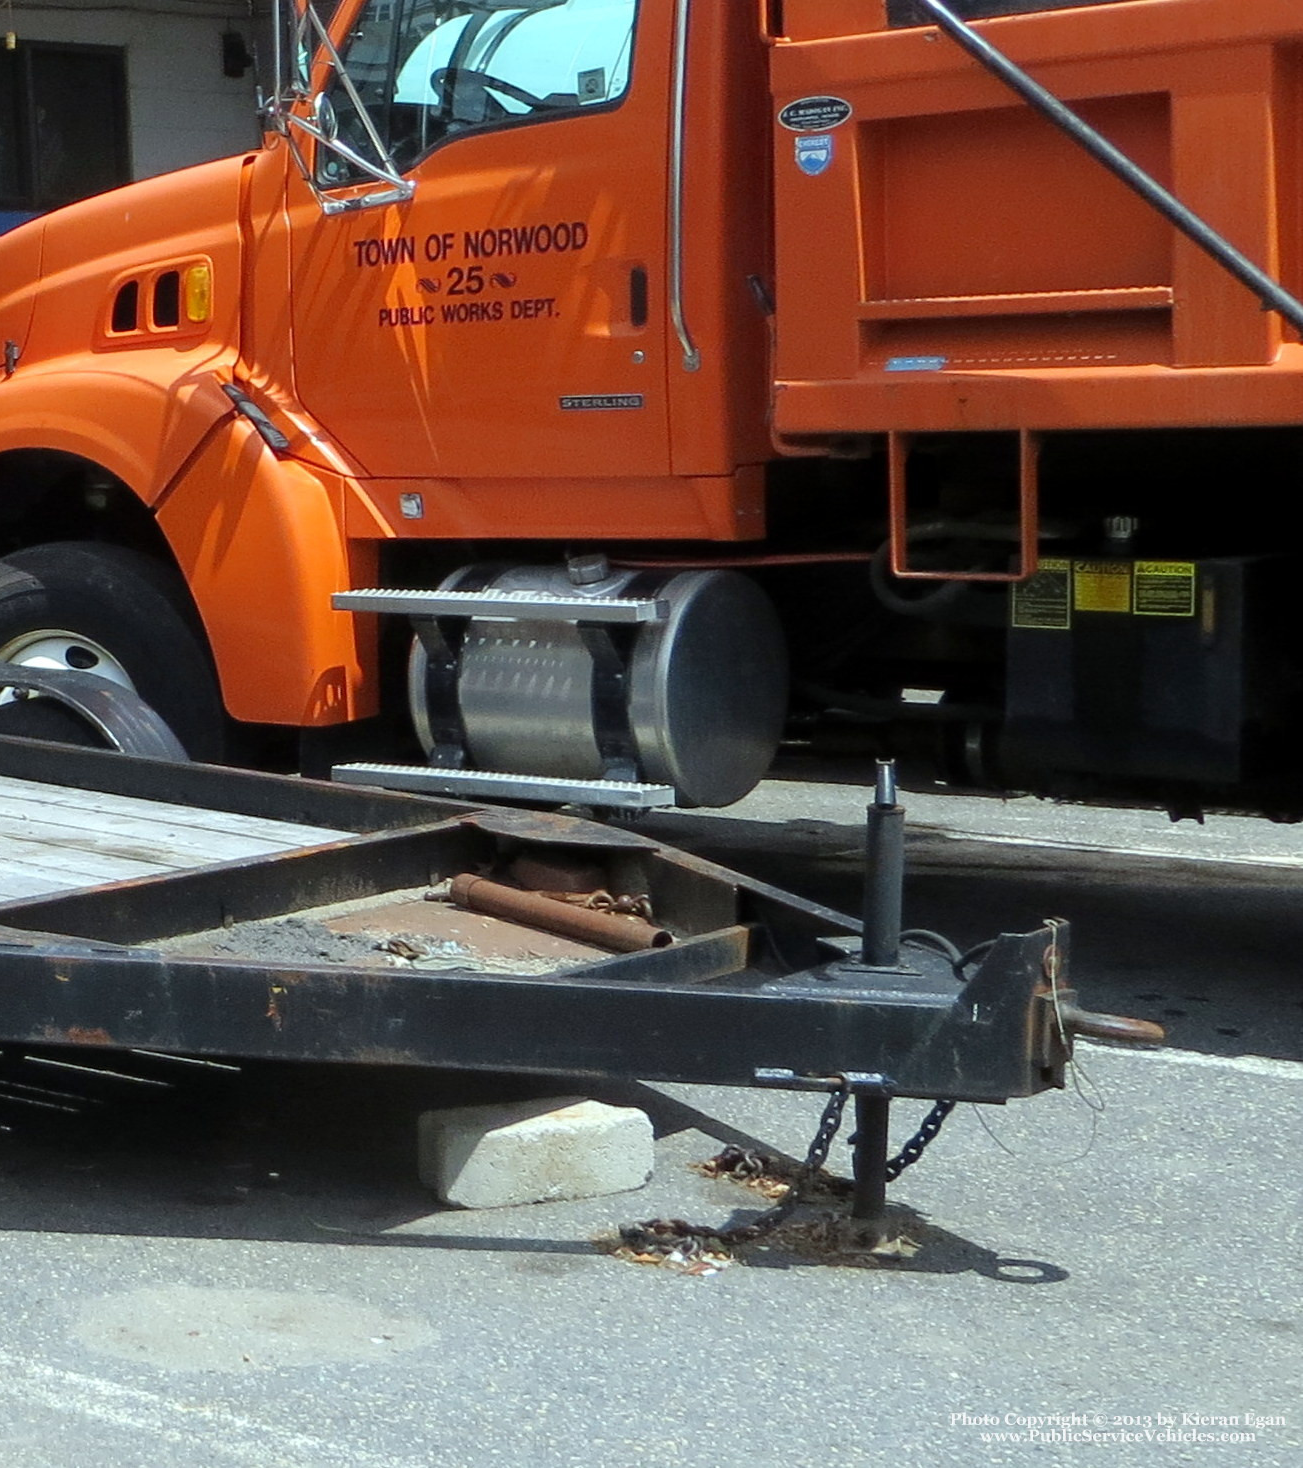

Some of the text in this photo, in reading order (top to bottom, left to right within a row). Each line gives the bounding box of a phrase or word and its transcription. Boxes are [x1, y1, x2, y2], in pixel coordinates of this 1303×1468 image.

[354, 222, 588, 268] TOWN OF NORWOOD
[446, 266, 485, 296] 25
[378, 298, 561, 327] PUBLIC WORKS DEPT.
[561, 396, 643, 409] STERLING
[1146, 565, 1192, 574] CAUTION
